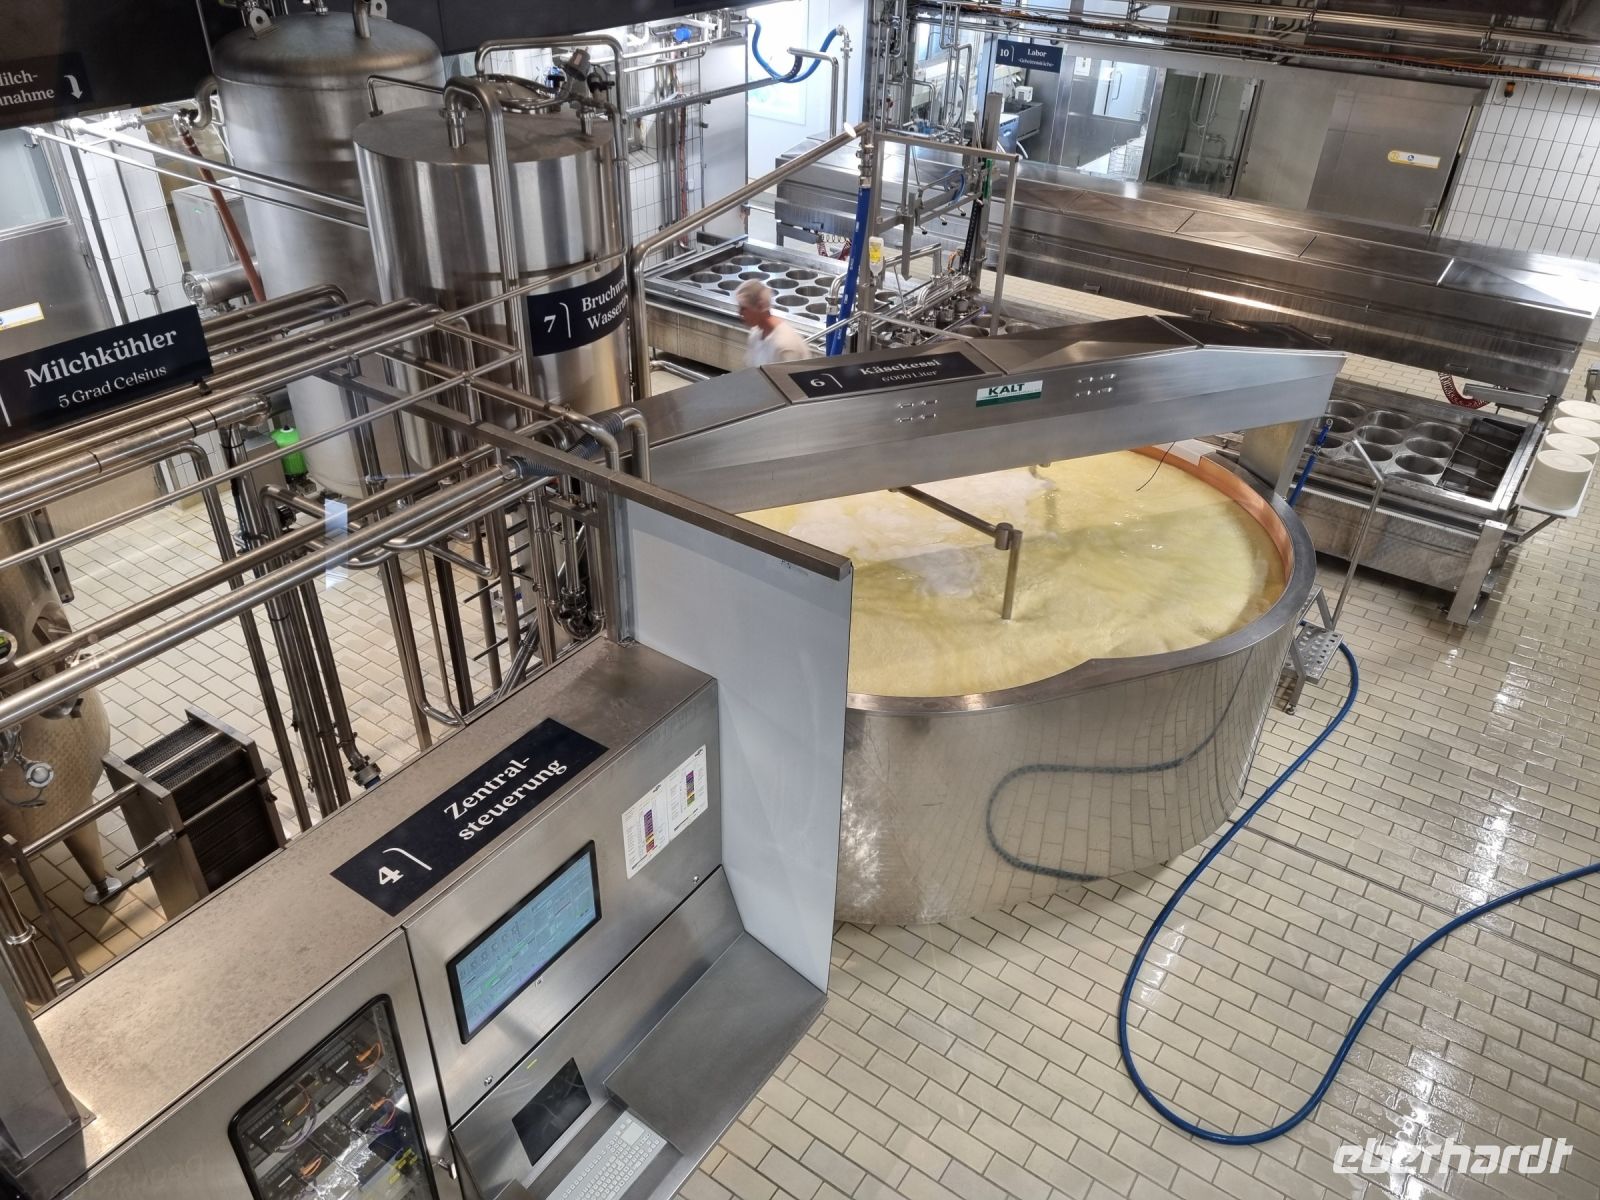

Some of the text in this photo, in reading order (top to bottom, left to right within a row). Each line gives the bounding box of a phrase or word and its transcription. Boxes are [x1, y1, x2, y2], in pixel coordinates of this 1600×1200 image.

[1000, 48, 1010, 57] 10
[1027, 48, 1047, 58] Labor
[0, 70, 39, 87] ilch-
[543, 314, 557, 333] 7
[24, 330, 178, 388] Milchkühler
[860, 359, 941, 376] Käsekessi
[58, 365, 168, 409] 5 Grad Celsius
[810, 378, 825, 387] 6
[989, 383, 1024, 396] KALT
[443, 755, 531, 820] Zentral-
[458, 759, 568, 840] steuerung
[377, 865, 404, 885] 4
